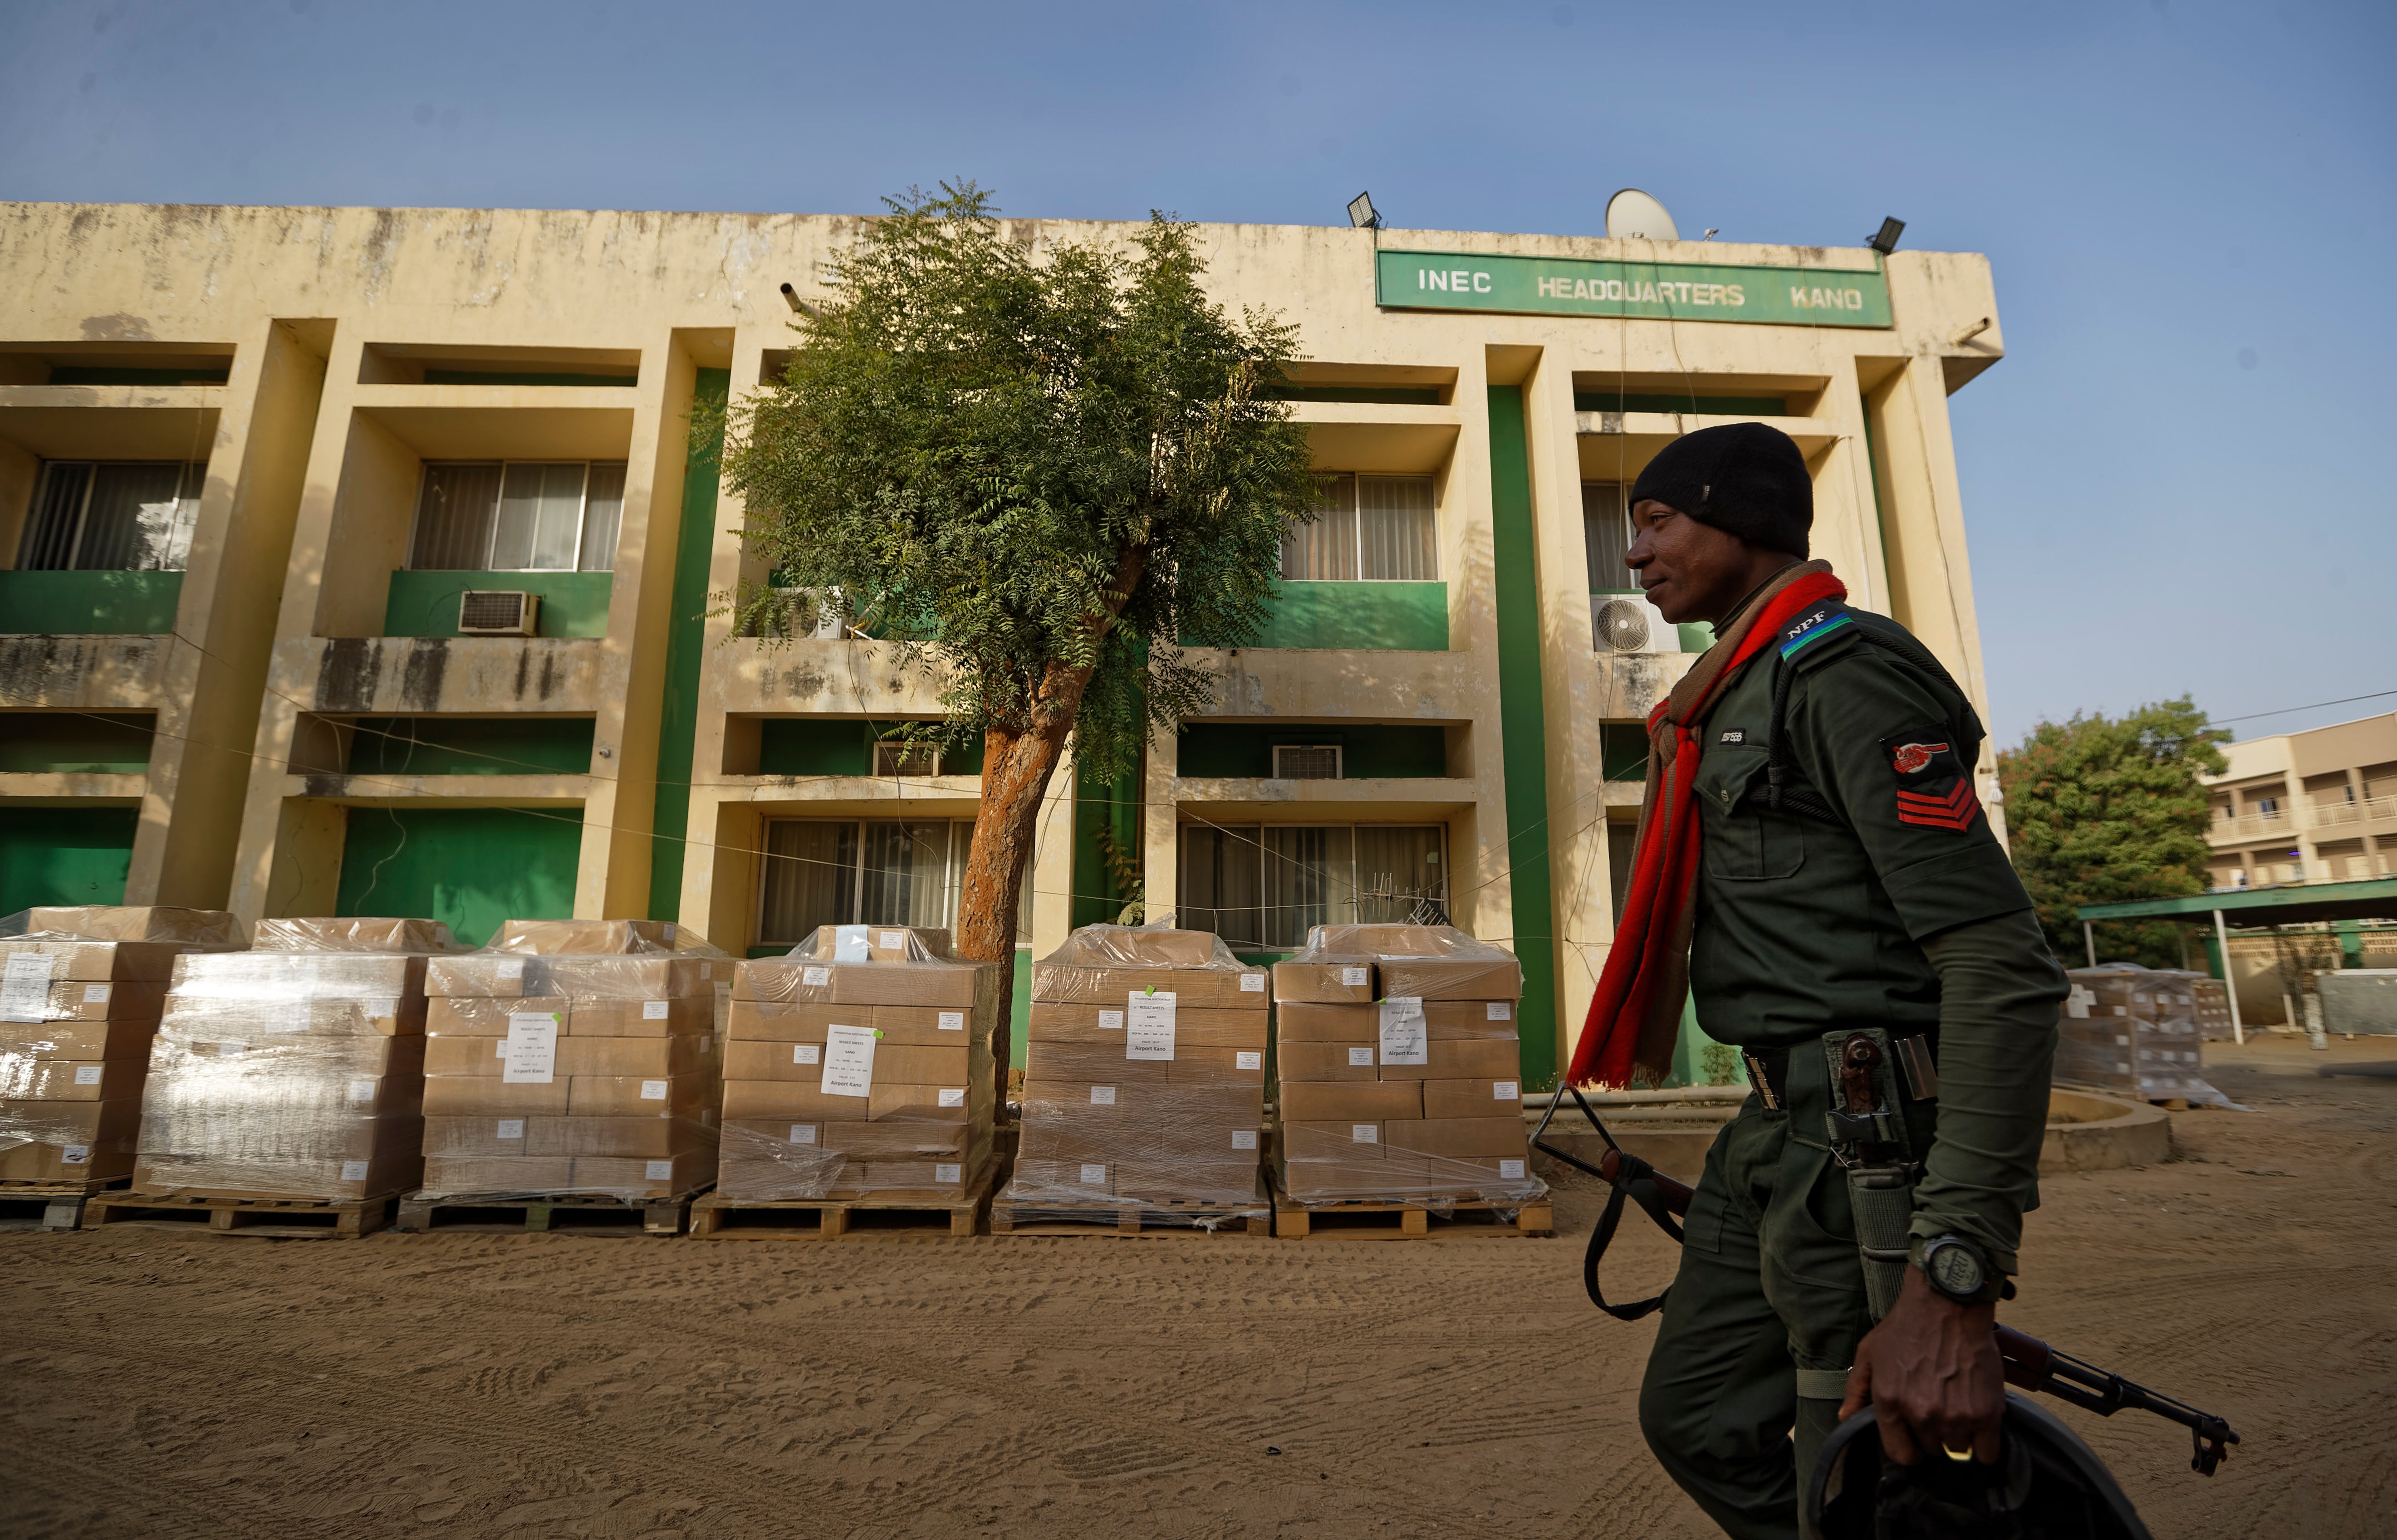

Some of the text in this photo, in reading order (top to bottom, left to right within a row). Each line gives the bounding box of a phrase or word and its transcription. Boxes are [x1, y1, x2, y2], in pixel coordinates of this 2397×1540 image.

[1419, 269, 1862, 310] INEC HEADQUARTERS KANO
[1787, 611, 1825, 640] NPF
